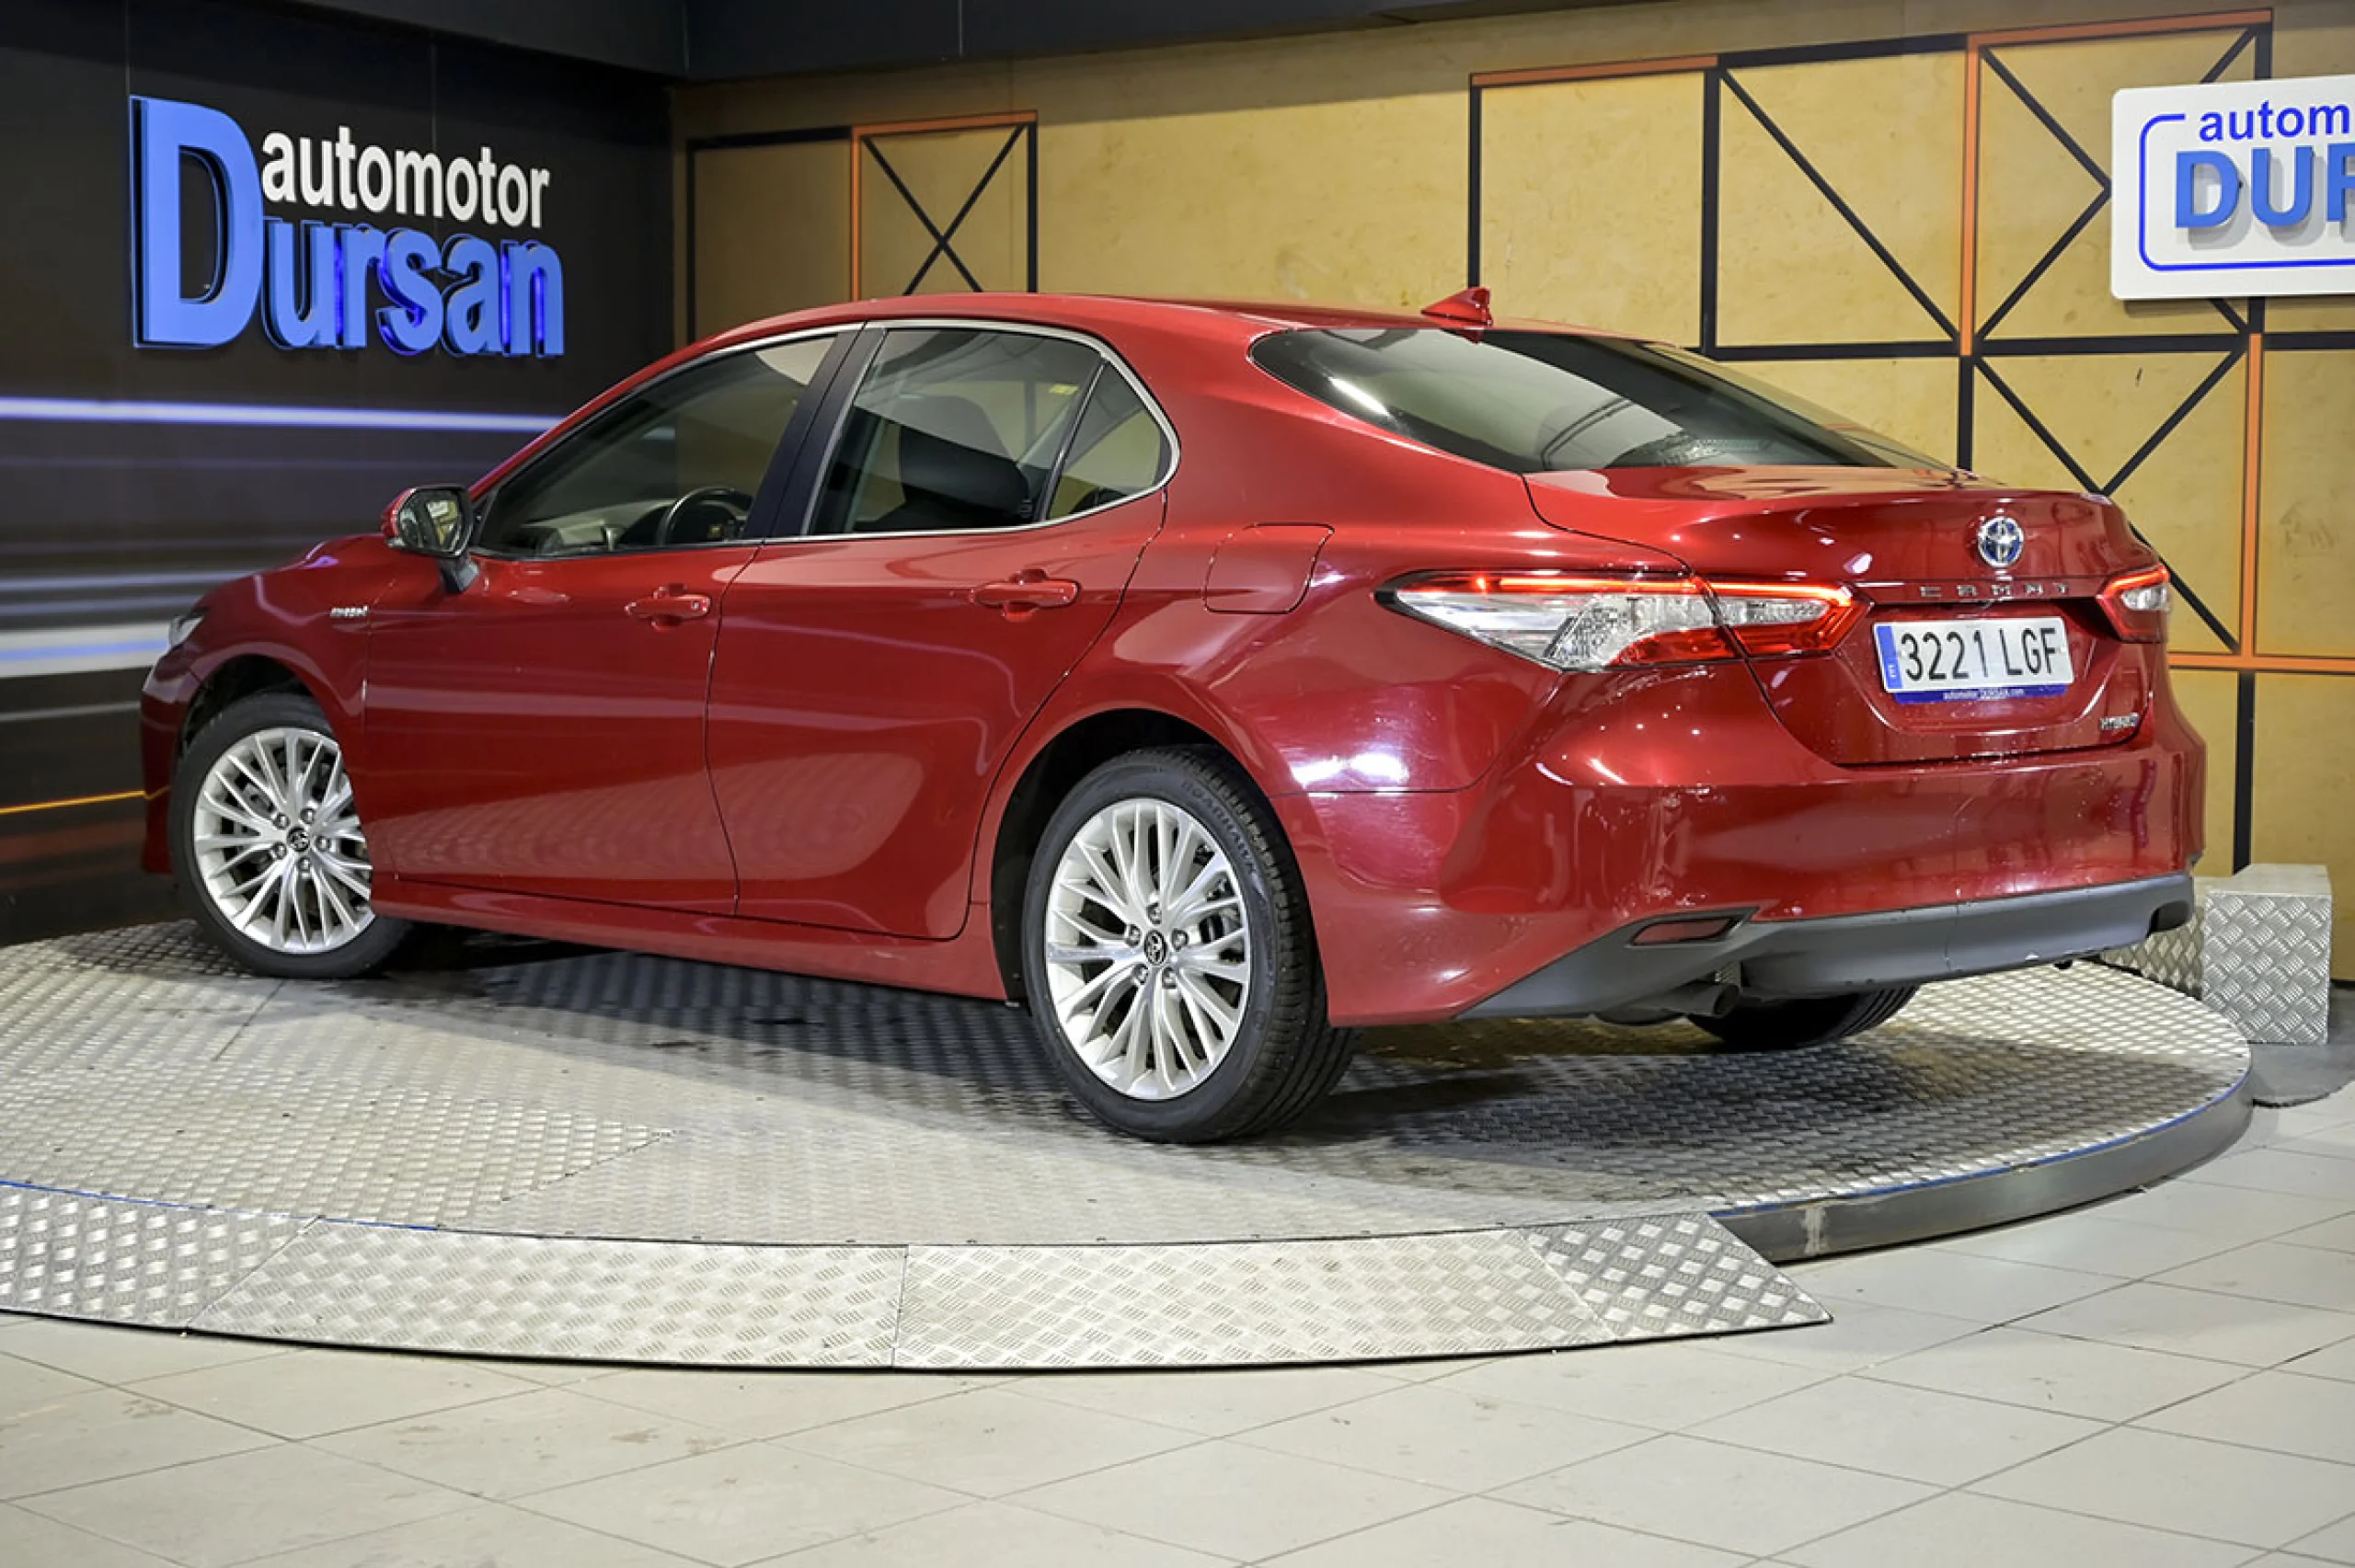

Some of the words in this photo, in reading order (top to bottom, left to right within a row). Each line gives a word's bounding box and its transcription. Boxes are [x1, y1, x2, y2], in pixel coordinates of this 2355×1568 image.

[130, 95, 565, 357] Dursan
[262, 126, 550, 228] automotor
[1901, 630, 1989, 681] 3221
[1998, 627, 2057, 676] LGF
